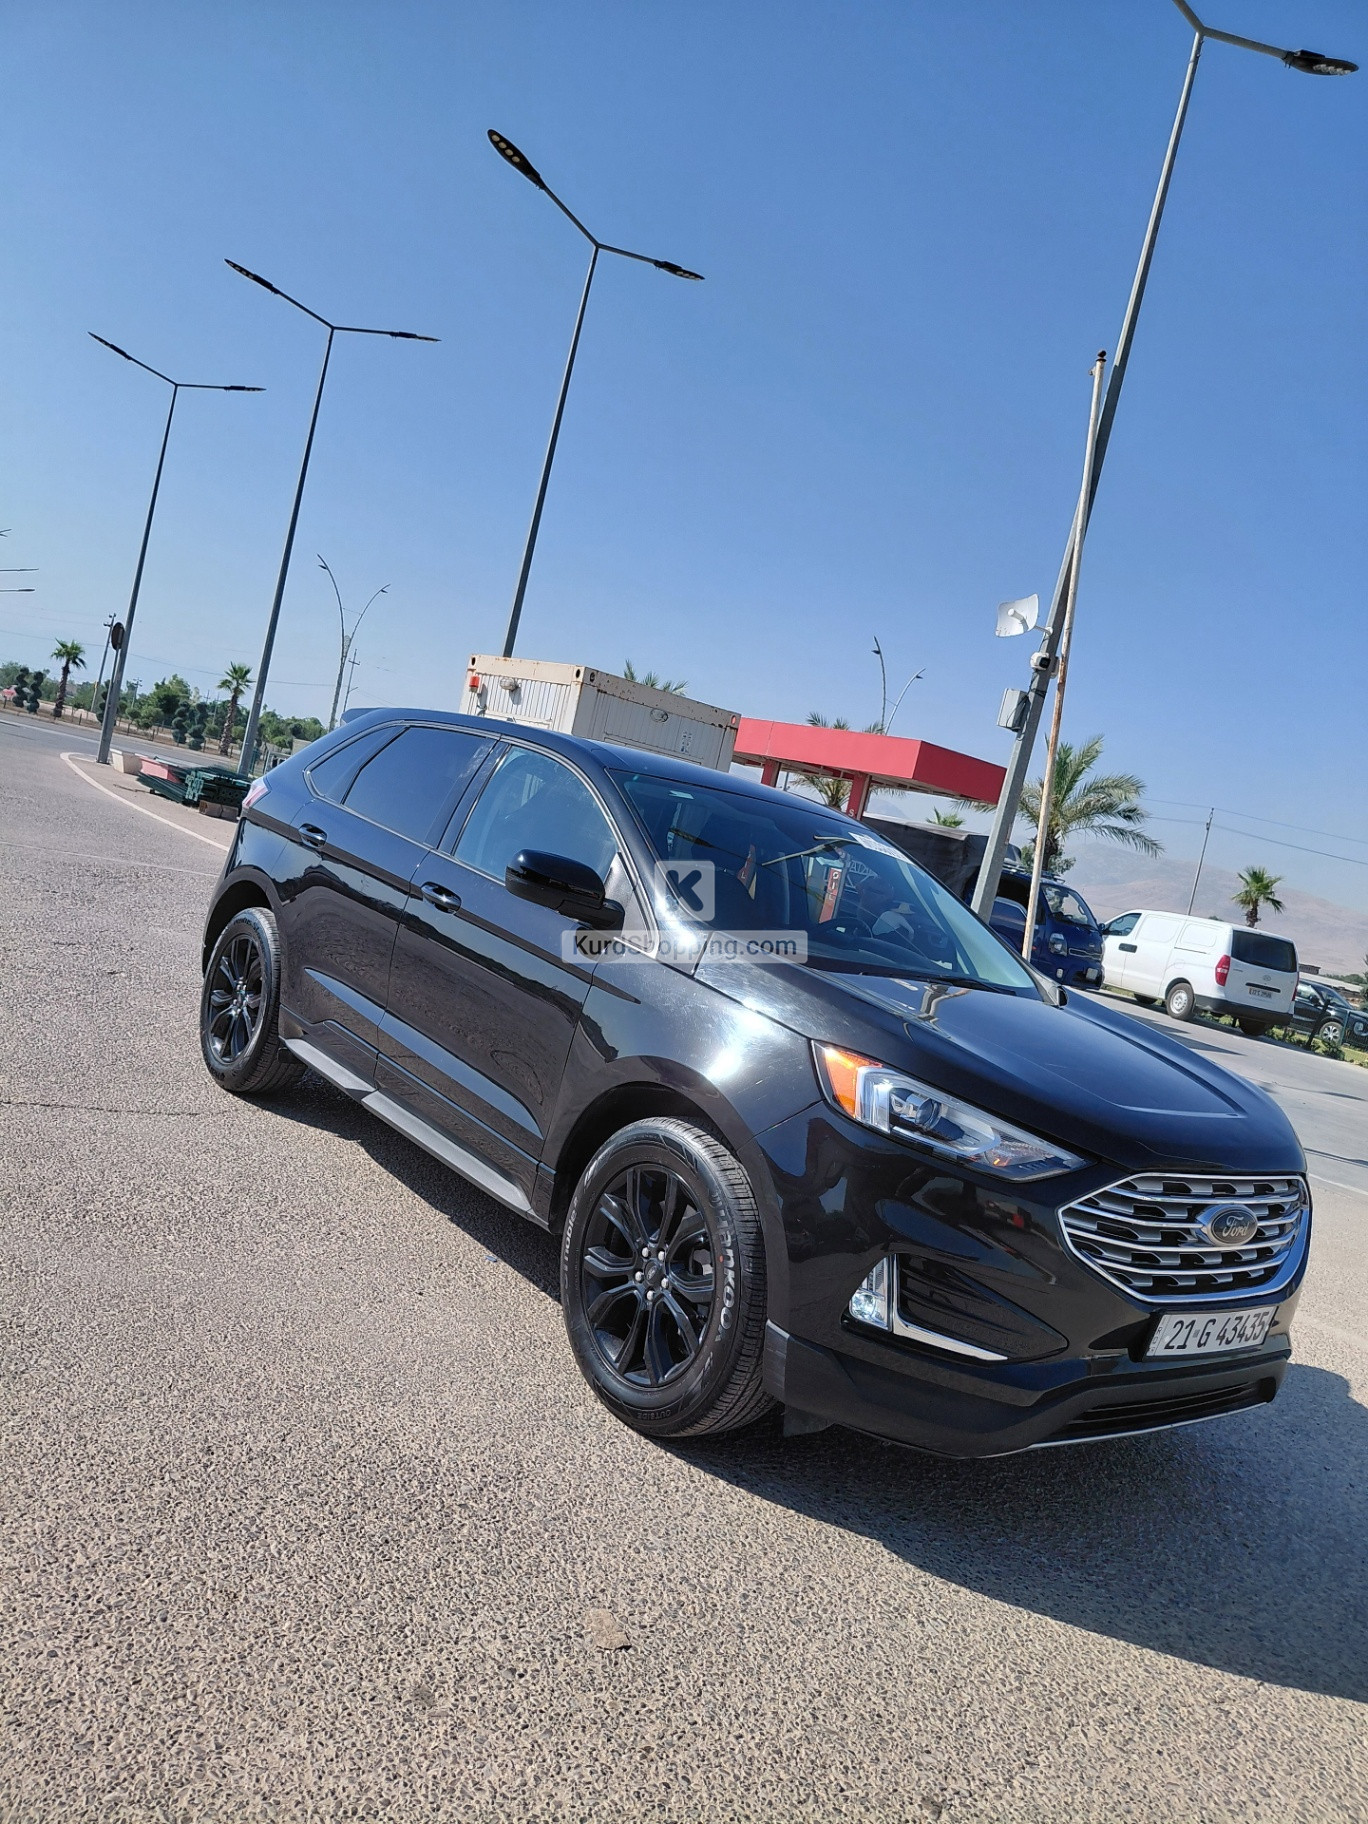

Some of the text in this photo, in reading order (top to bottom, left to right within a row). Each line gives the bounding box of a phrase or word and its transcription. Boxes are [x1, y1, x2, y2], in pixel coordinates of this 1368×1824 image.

[1222, 1215, 1250, 1237] Ford
[1164, 1312, 1270, 1350] 21 G 43435
